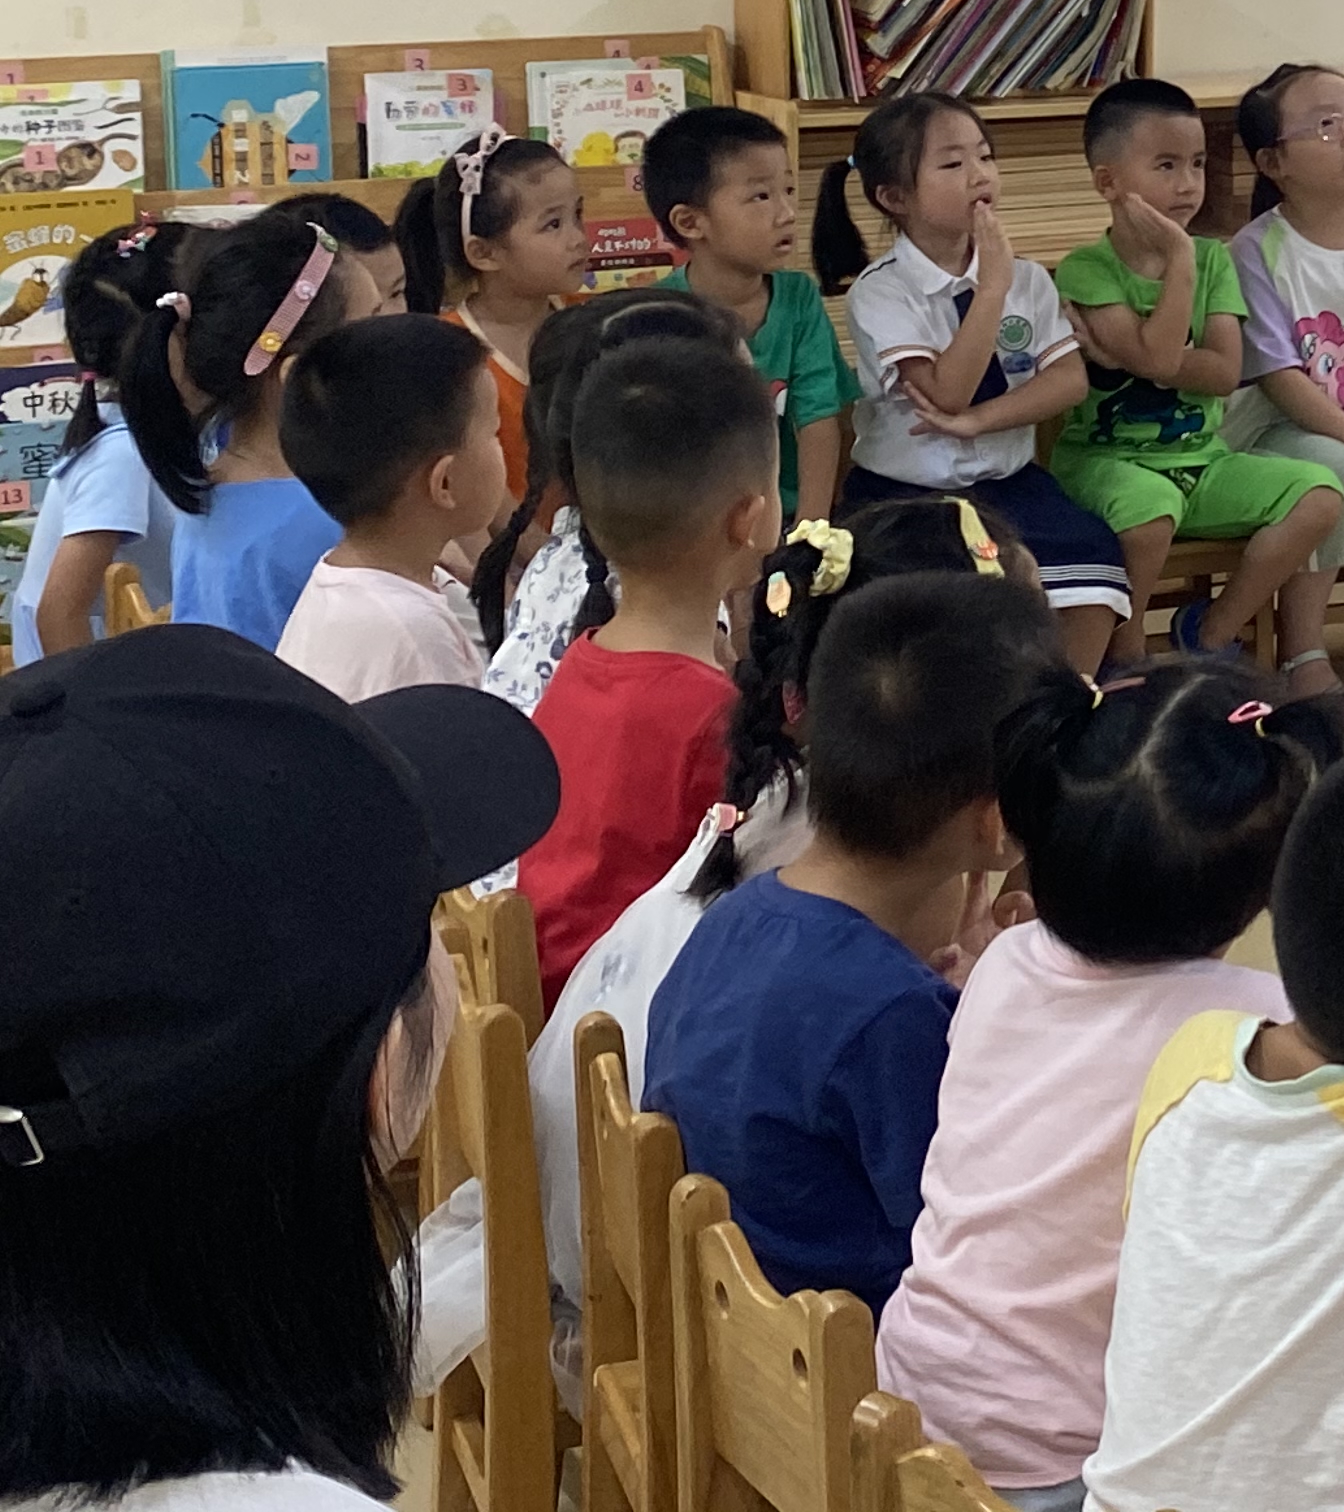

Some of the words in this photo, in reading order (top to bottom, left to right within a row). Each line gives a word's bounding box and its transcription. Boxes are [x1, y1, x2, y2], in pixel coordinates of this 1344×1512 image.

[456, 78, 468, 92] 3
[634, 80, 644, 93] 4
[35, 150, 45, 166] 1
[632, 174, 643, 192] 8
[22, 390, 84, 419] 中秋
[1, 488, 24, 505] 13
